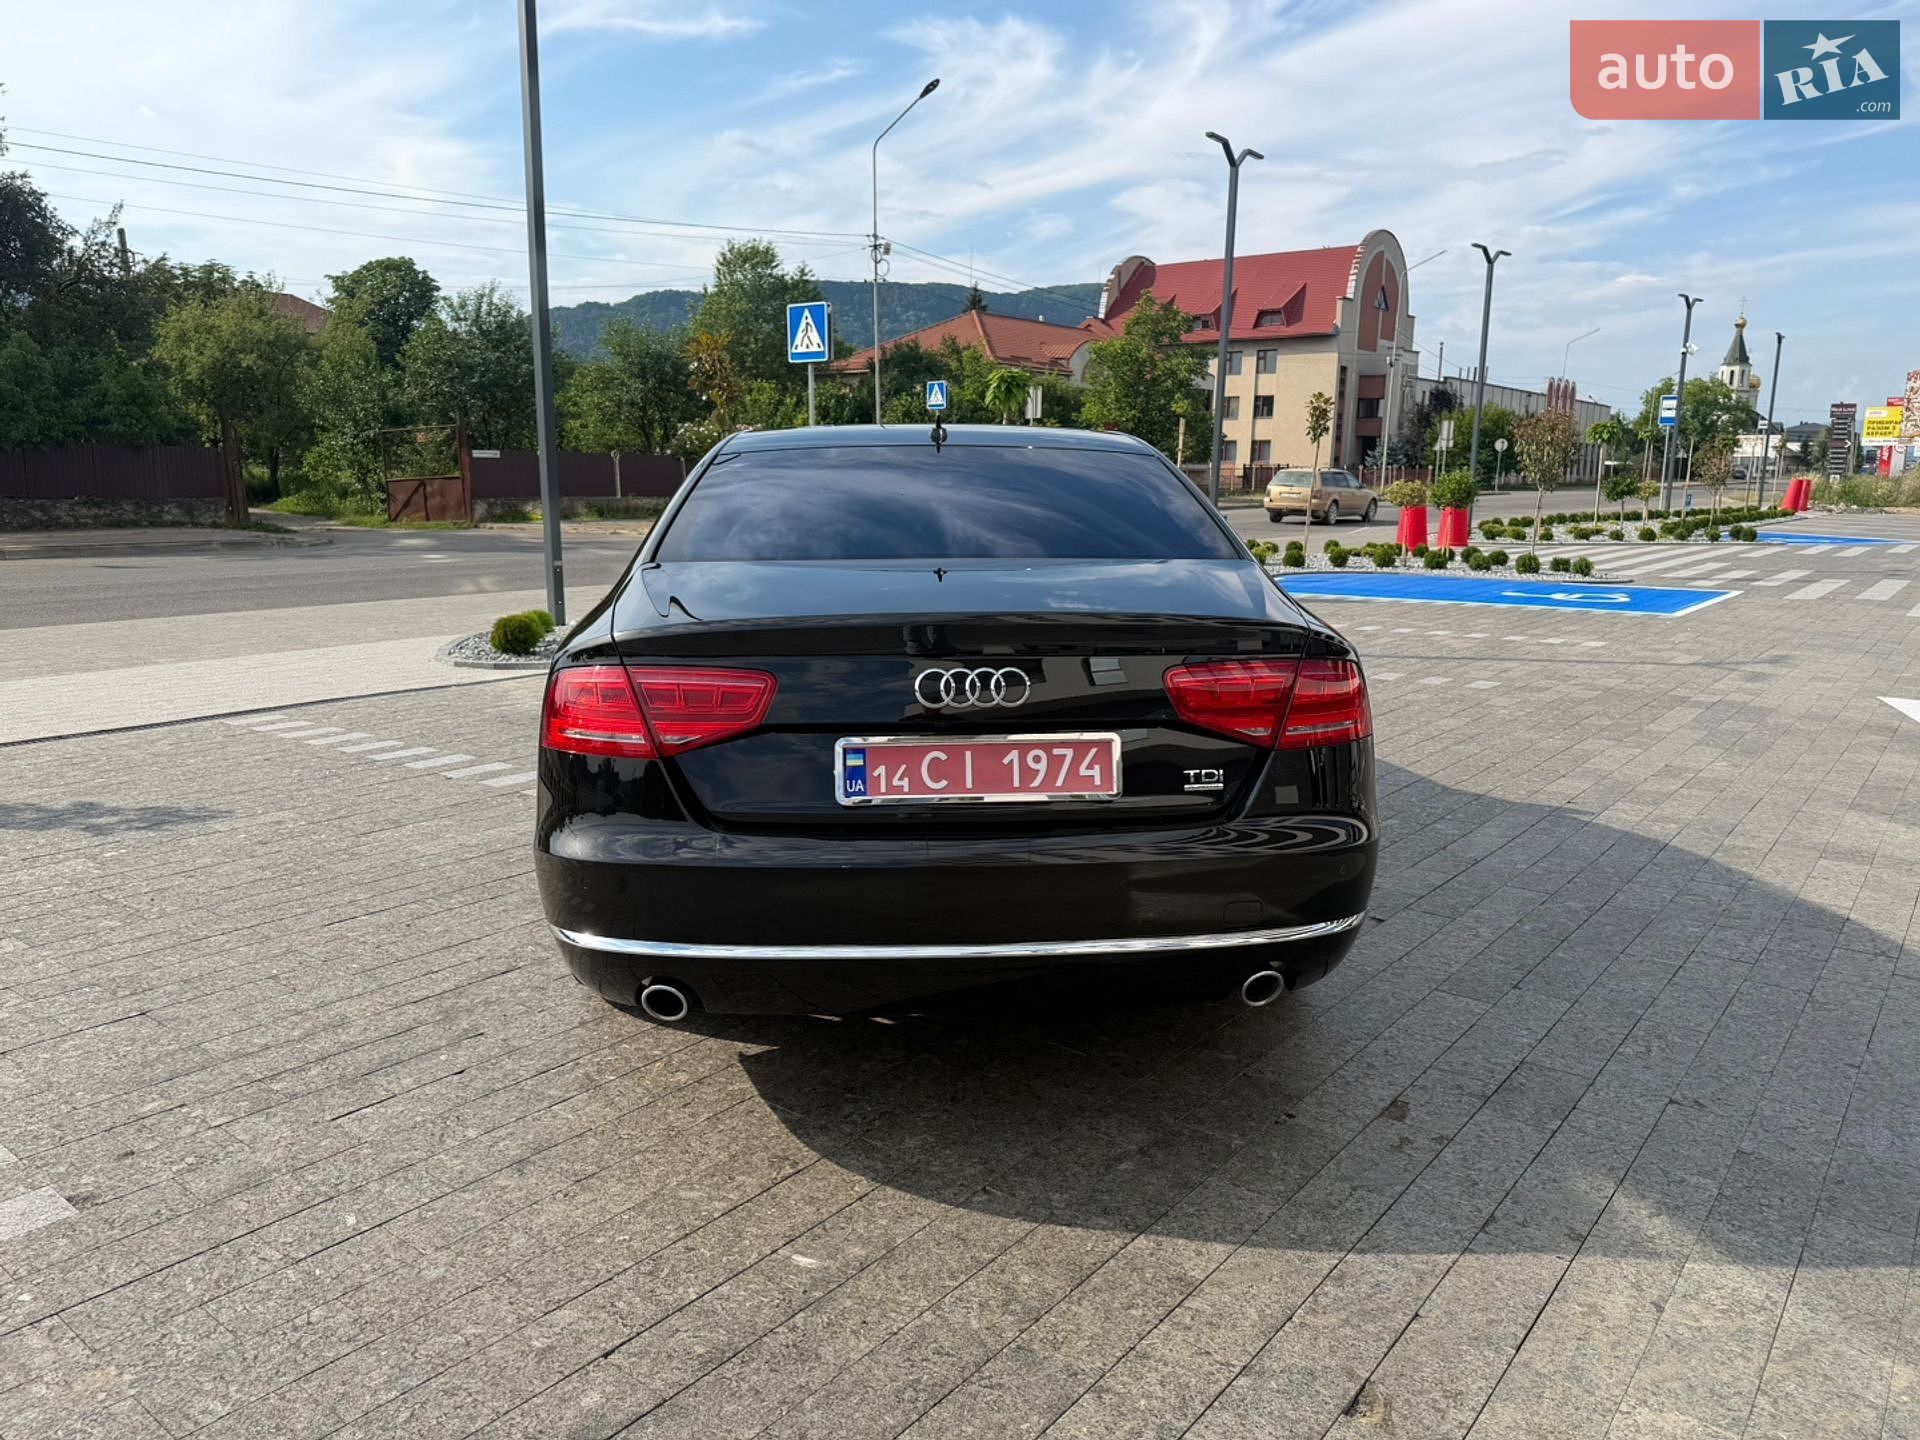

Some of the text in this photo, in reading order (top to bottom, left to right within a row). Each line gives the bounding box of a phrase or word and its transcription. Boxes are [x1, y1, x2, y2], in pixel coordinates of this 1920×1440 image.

[872, 747, 1102, 793] 14 CI 1974
[1183, 769, 1224, 783] TDI
[846, 780, 865, 793] UA
